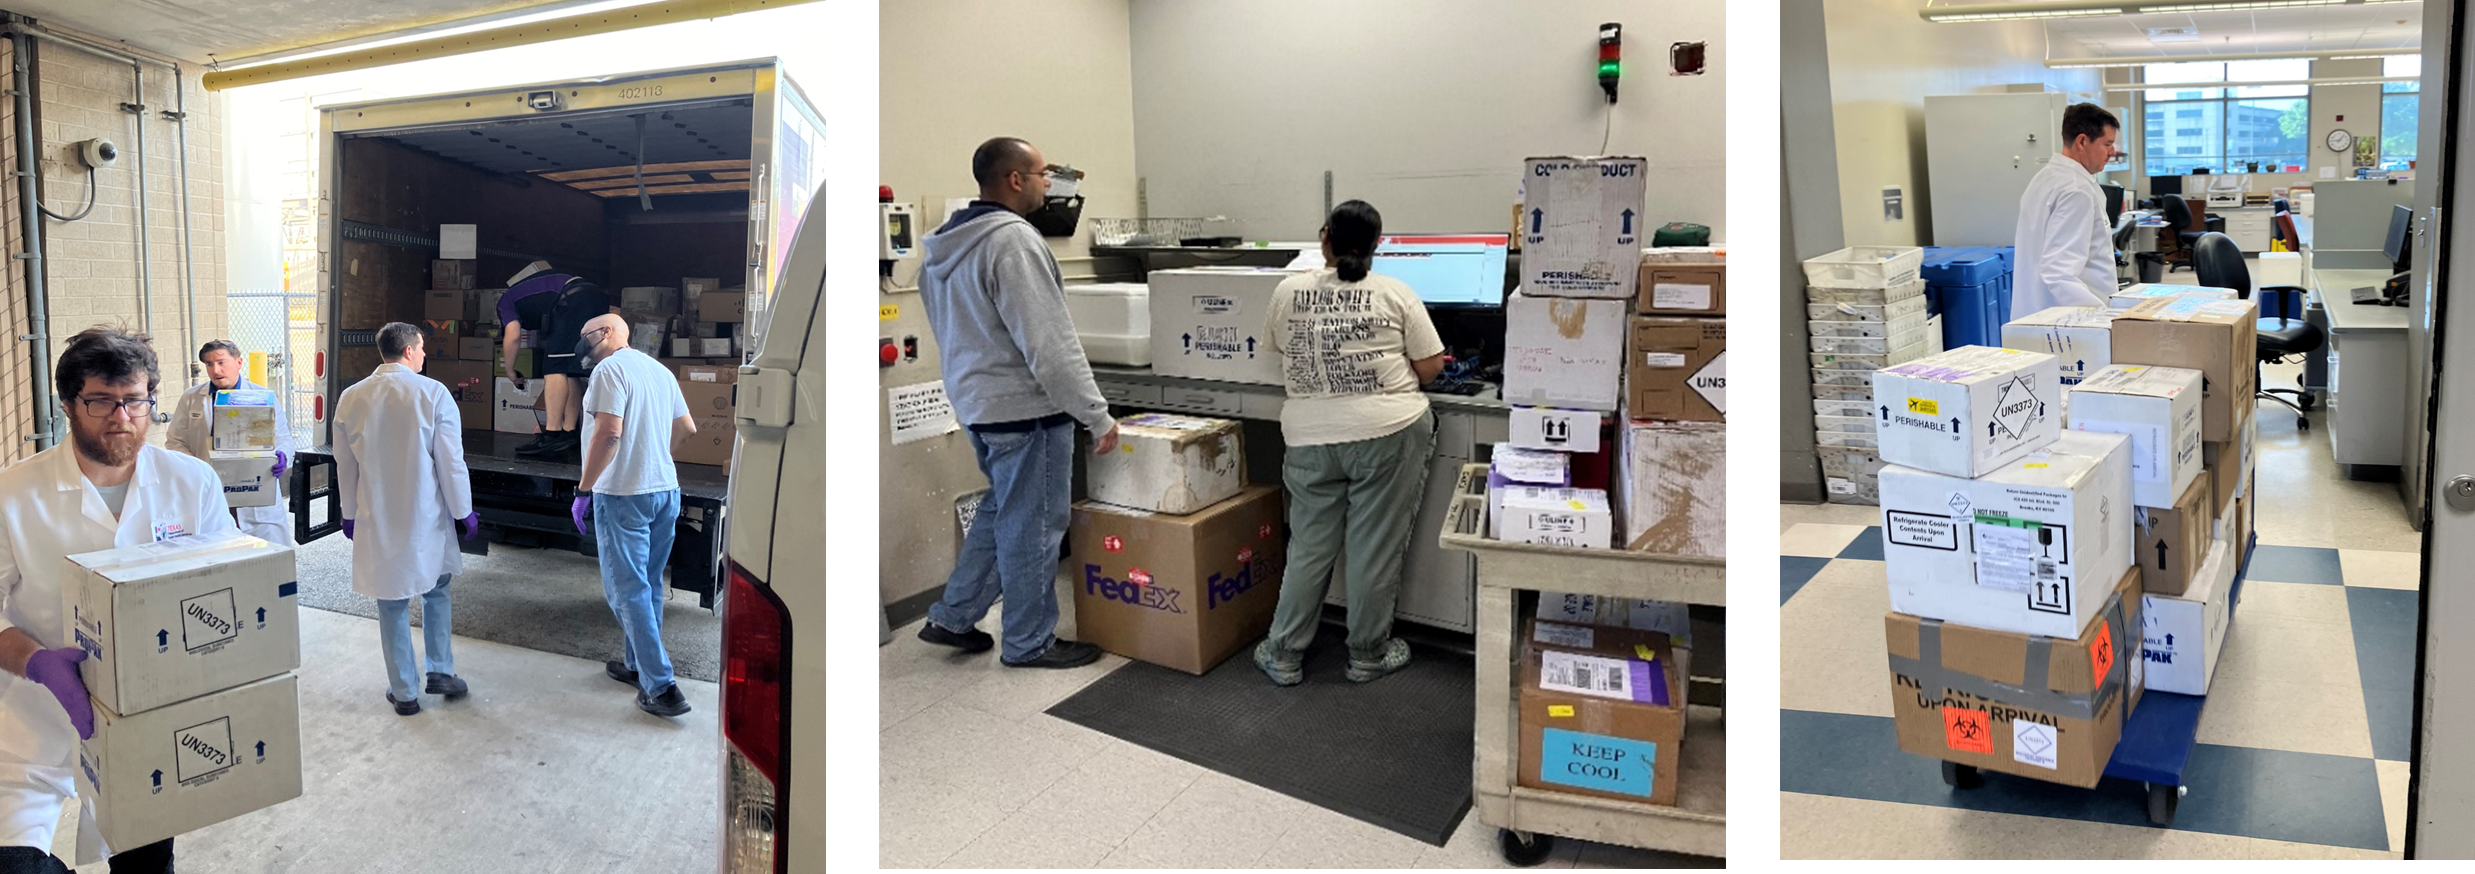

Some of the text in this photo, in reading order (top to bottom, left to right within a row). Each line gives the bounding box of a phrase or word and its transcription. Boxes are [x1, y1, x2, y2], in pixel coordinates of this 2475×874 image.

[1573, 164, 1637, 178] DUCT
[1528, 236, 1545, 244] UP
[1617, 237, 1634, 245] UP
[1293, 289, 1374, 306] TAYLOR SWIFT
[2001, 399, 2033, 418] UN3373
[1895, 415, 1946, 433] PERISHABLE
[1893, 516, 1949, 528] Refrigerate Cooler
[1899, 525, 1945, 536] Contents Upon
[1912, 535, 1933, 543] Arrival
[187, 602, 231, 635] UN3373
[157, 646, 169, 654] UP
[181, 733, 226, 766] UN3373
[1572, 742, 1626, 762] KEEP
[256, 757, 266, 765] UP
[1567, 762, 1626, 781] COOL
[152, 786, 163, 795] UP
